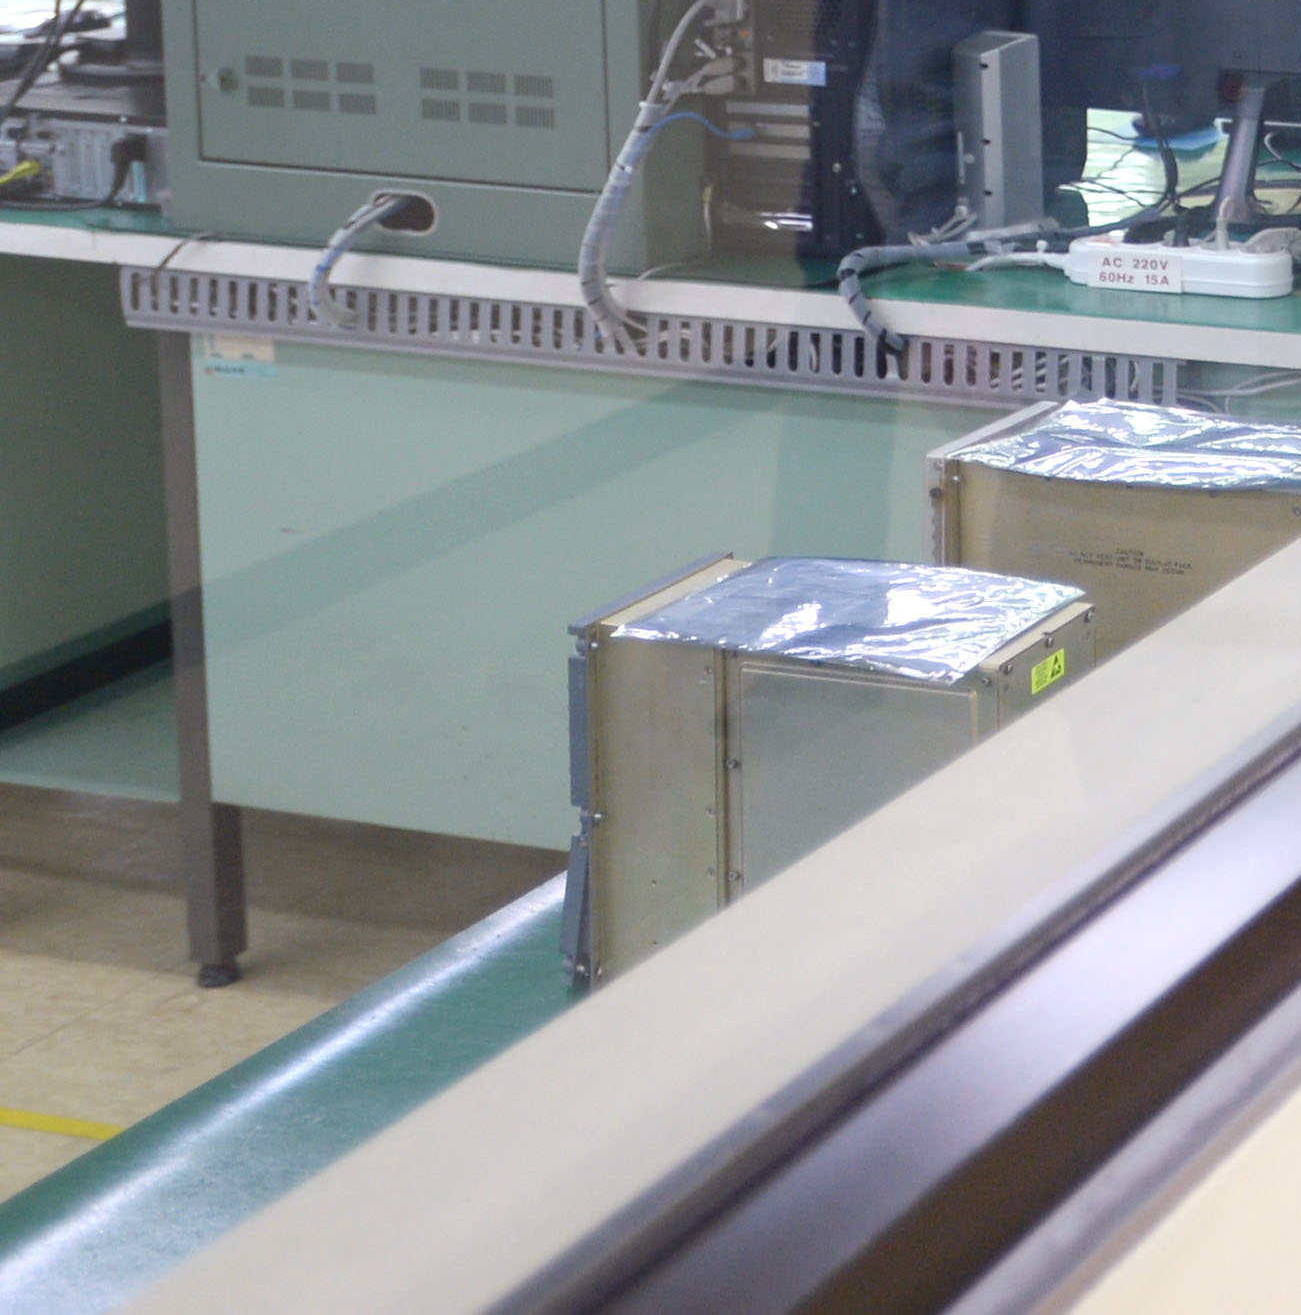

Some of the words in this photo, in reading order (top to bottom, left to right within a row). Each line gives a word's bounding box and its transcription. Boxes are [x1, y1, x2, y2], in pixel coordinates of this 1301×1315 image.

[1101, 256, 1123, 268] AC
[1132, 258, 1168, 271] 220V
[1099, 271, 1135, 284] 60Hz
[1145, 274, 1170, 286] 15A
